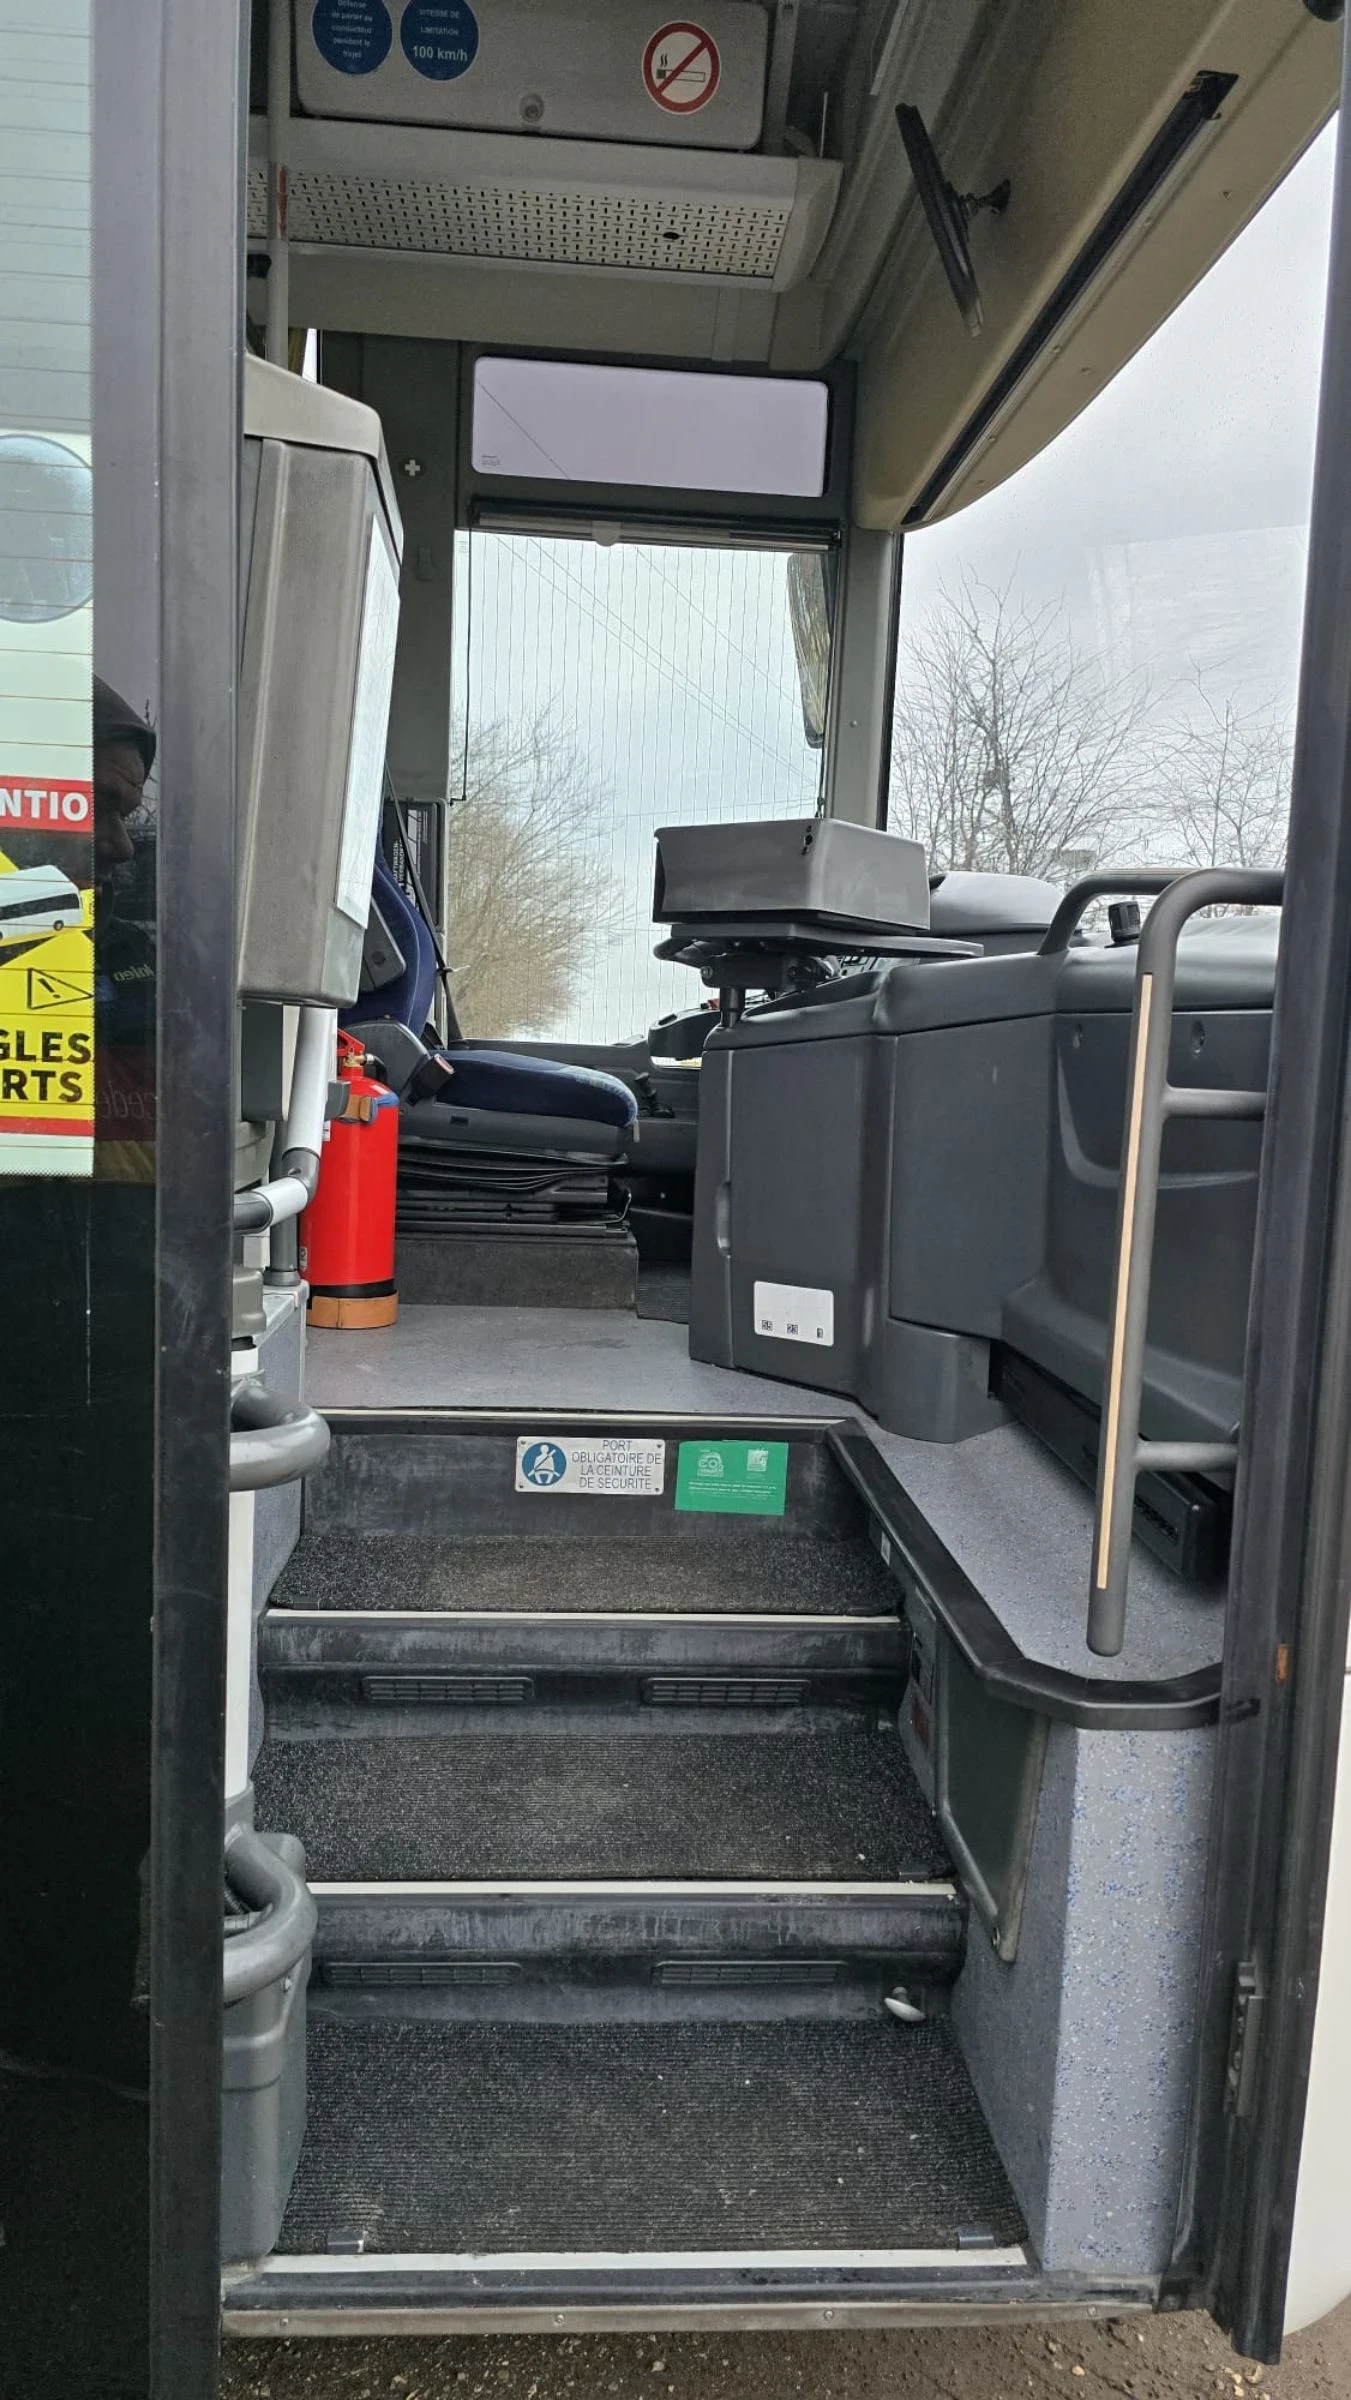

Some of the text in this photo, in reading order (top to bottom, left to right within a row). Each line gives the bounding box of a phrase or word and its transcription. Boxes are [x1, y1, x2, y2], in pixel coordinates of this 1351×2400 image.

[413, 45, 468, 62] 100 km/h
[2, 1068, 83, 1103] RTS
[602, 1439, 632, 1451] PORT
[571, 1451, 662, 1465] OBLIGATOIRE DE
[581, 1464, 652, 1477] LA CEINTURE
[578, 1476, 594, 1489] DE
